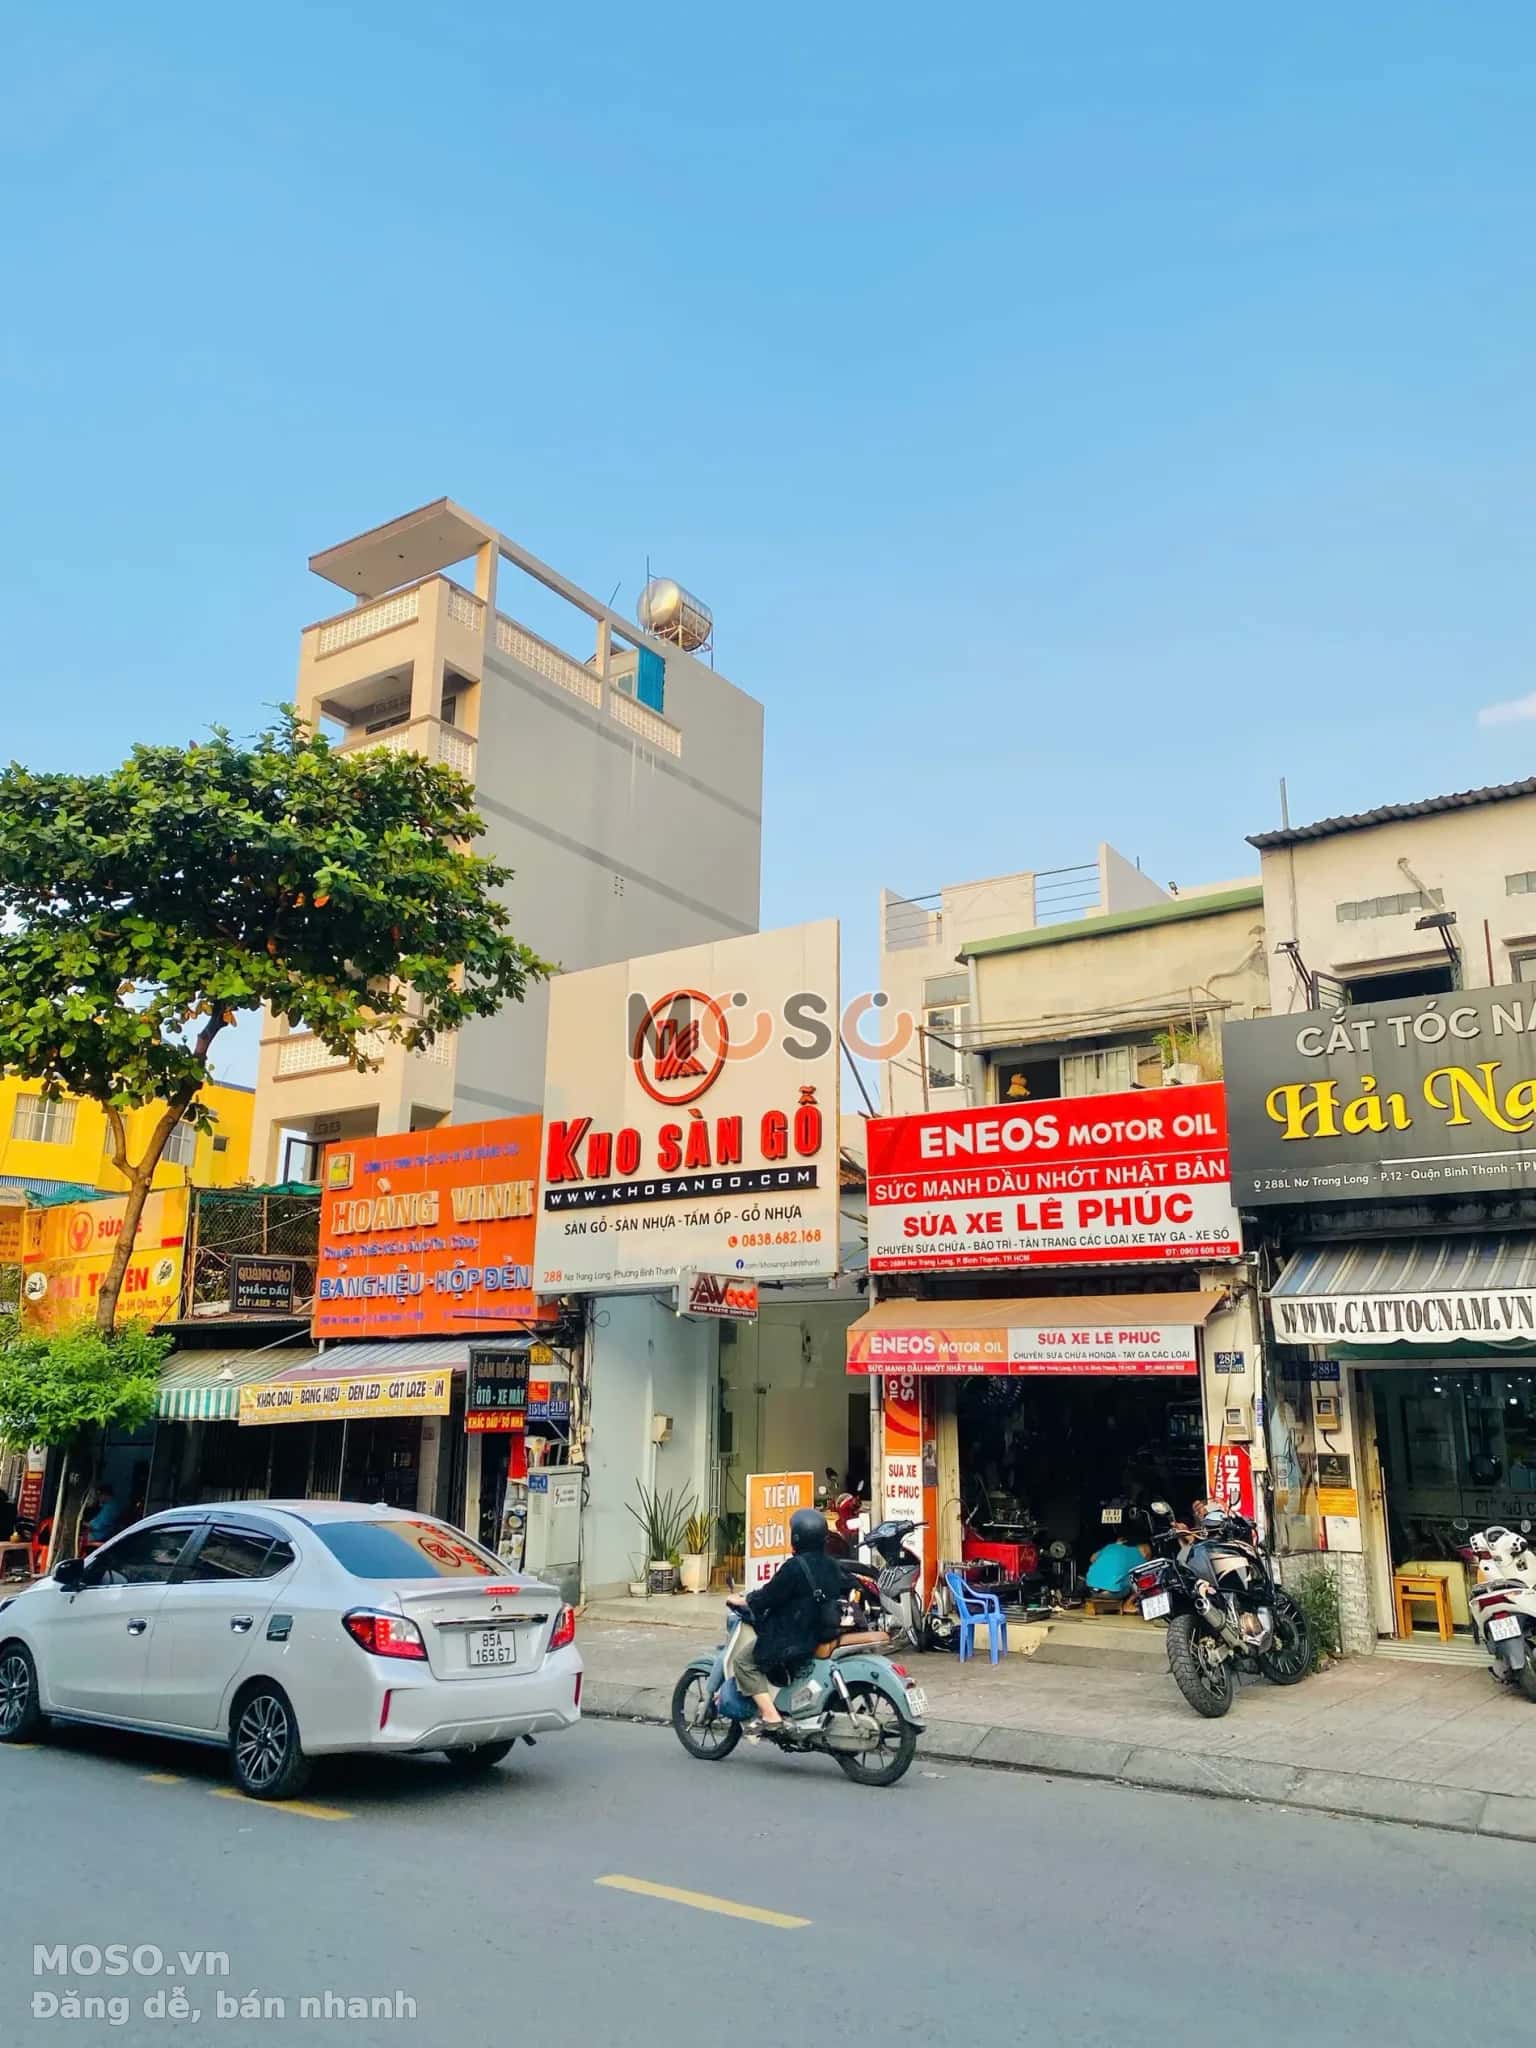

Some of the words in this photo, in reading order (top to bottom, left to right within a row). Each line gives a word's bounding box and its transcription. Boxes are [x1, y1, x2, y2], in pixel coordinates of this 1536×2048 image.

[1296, 1007, 1375, 1056] CẮT
[1387, 1001, 1480, 1047] TÓC
[1265, 1075, 1413, 1141] Hải
[547, 1117, 641, 1183] KHO
[657, 1107, 742, 1172] SÀN
[760, 1085, 822, 1161] GỖ
[920, 1115, 1060, 1159] ENEOS
[1068, 1118, 1163, 1147] MOTOR
[1172, 1112, 1217, 1139] OIL
[550, 1170, 811, 1205] WWW.KHOSANGO.COM
[875, 1179, 917, 1200] SỨC
[922, 1176, 981, 1200] MẠNH
[987, 1168, 1030, 1193] DẦU
[1036, 1165, 1099, 1190] NHỚT
[1105, 1160, 1168, 1187] NHẬT
[1175, 1155, 1225, 1180] BẢN
[1265, 1179, 1291, 1189] 288L
[1380, 1171, 1403, 1182] P.12
[1411, 1168, 1441, 1181] Quận
[1471, 1162, 1508, 1177] Thạnh
[331, 1177, 440, 1235] HOÀNG
[642, 1213, 676, 1231] NHỰA
[684, 1208, 710, 1226] TẤM
[713, 1207, 731, 1224] ỐP
[741, 1202, 760, 1221] GỖ
[764, 1204, 802, 1223] NHỰA
[966, 1210, 1004, 1234] XE
[1016, 1197, 1064, 1231] LÊ
[1078, 1190, 1193, 1229] PHÚC
[742, 1229, 821, 1247] 0838.682.168
[1041, 1236, 1077, 1248] TRANG
[1079, 1232, 1103, 1246] CÁC
[1132, 1232, 1145, 1244] XE
[1149, 1231, 1167, 1243] TAY
[1169, 1230, 1186, 1242] GA
[1195, 1229, 1210, 1241] XE
[239, 1283, 267, 1295] KHẮC
[269, 1284, 289, 1295] DẤU
[434, 1259, 481, 1300] HỘP
[483, 1255, 534, 1291] ĐÈN
[544, 1270, 562, 1284] 288
[1281, 1295, 1535, 1334] WWW.CATTOCNAM.VN
[870, 1336, 935, 1354] ENEOS
[938, 1342, 981, 1353] MOTOR
[984, 1342, 1003, 1353] OIL
[1072, 1332, 1090, 1345] XE
[1088, 1350, 1116, 1360] HONDA
[1123, 1350, 1136, 1359] TAY
[1138, 1350, 1150, 1359] GA
[366, 1382, 381, 1400] LED
[406, 1380, 426, 1398] LAZE
[497, 1388, 508, 1405] XE
[508, 1386, 526, 1405] MÁY
[907, 1464, 917, 1478] XE
[763, 1481, 800, 1514] TIỆM
[754, 1518, 784, 1550] SỬA
[482, 1632, 503, 1647] 85A
[475, 1647, 511, 1664] 169.67
